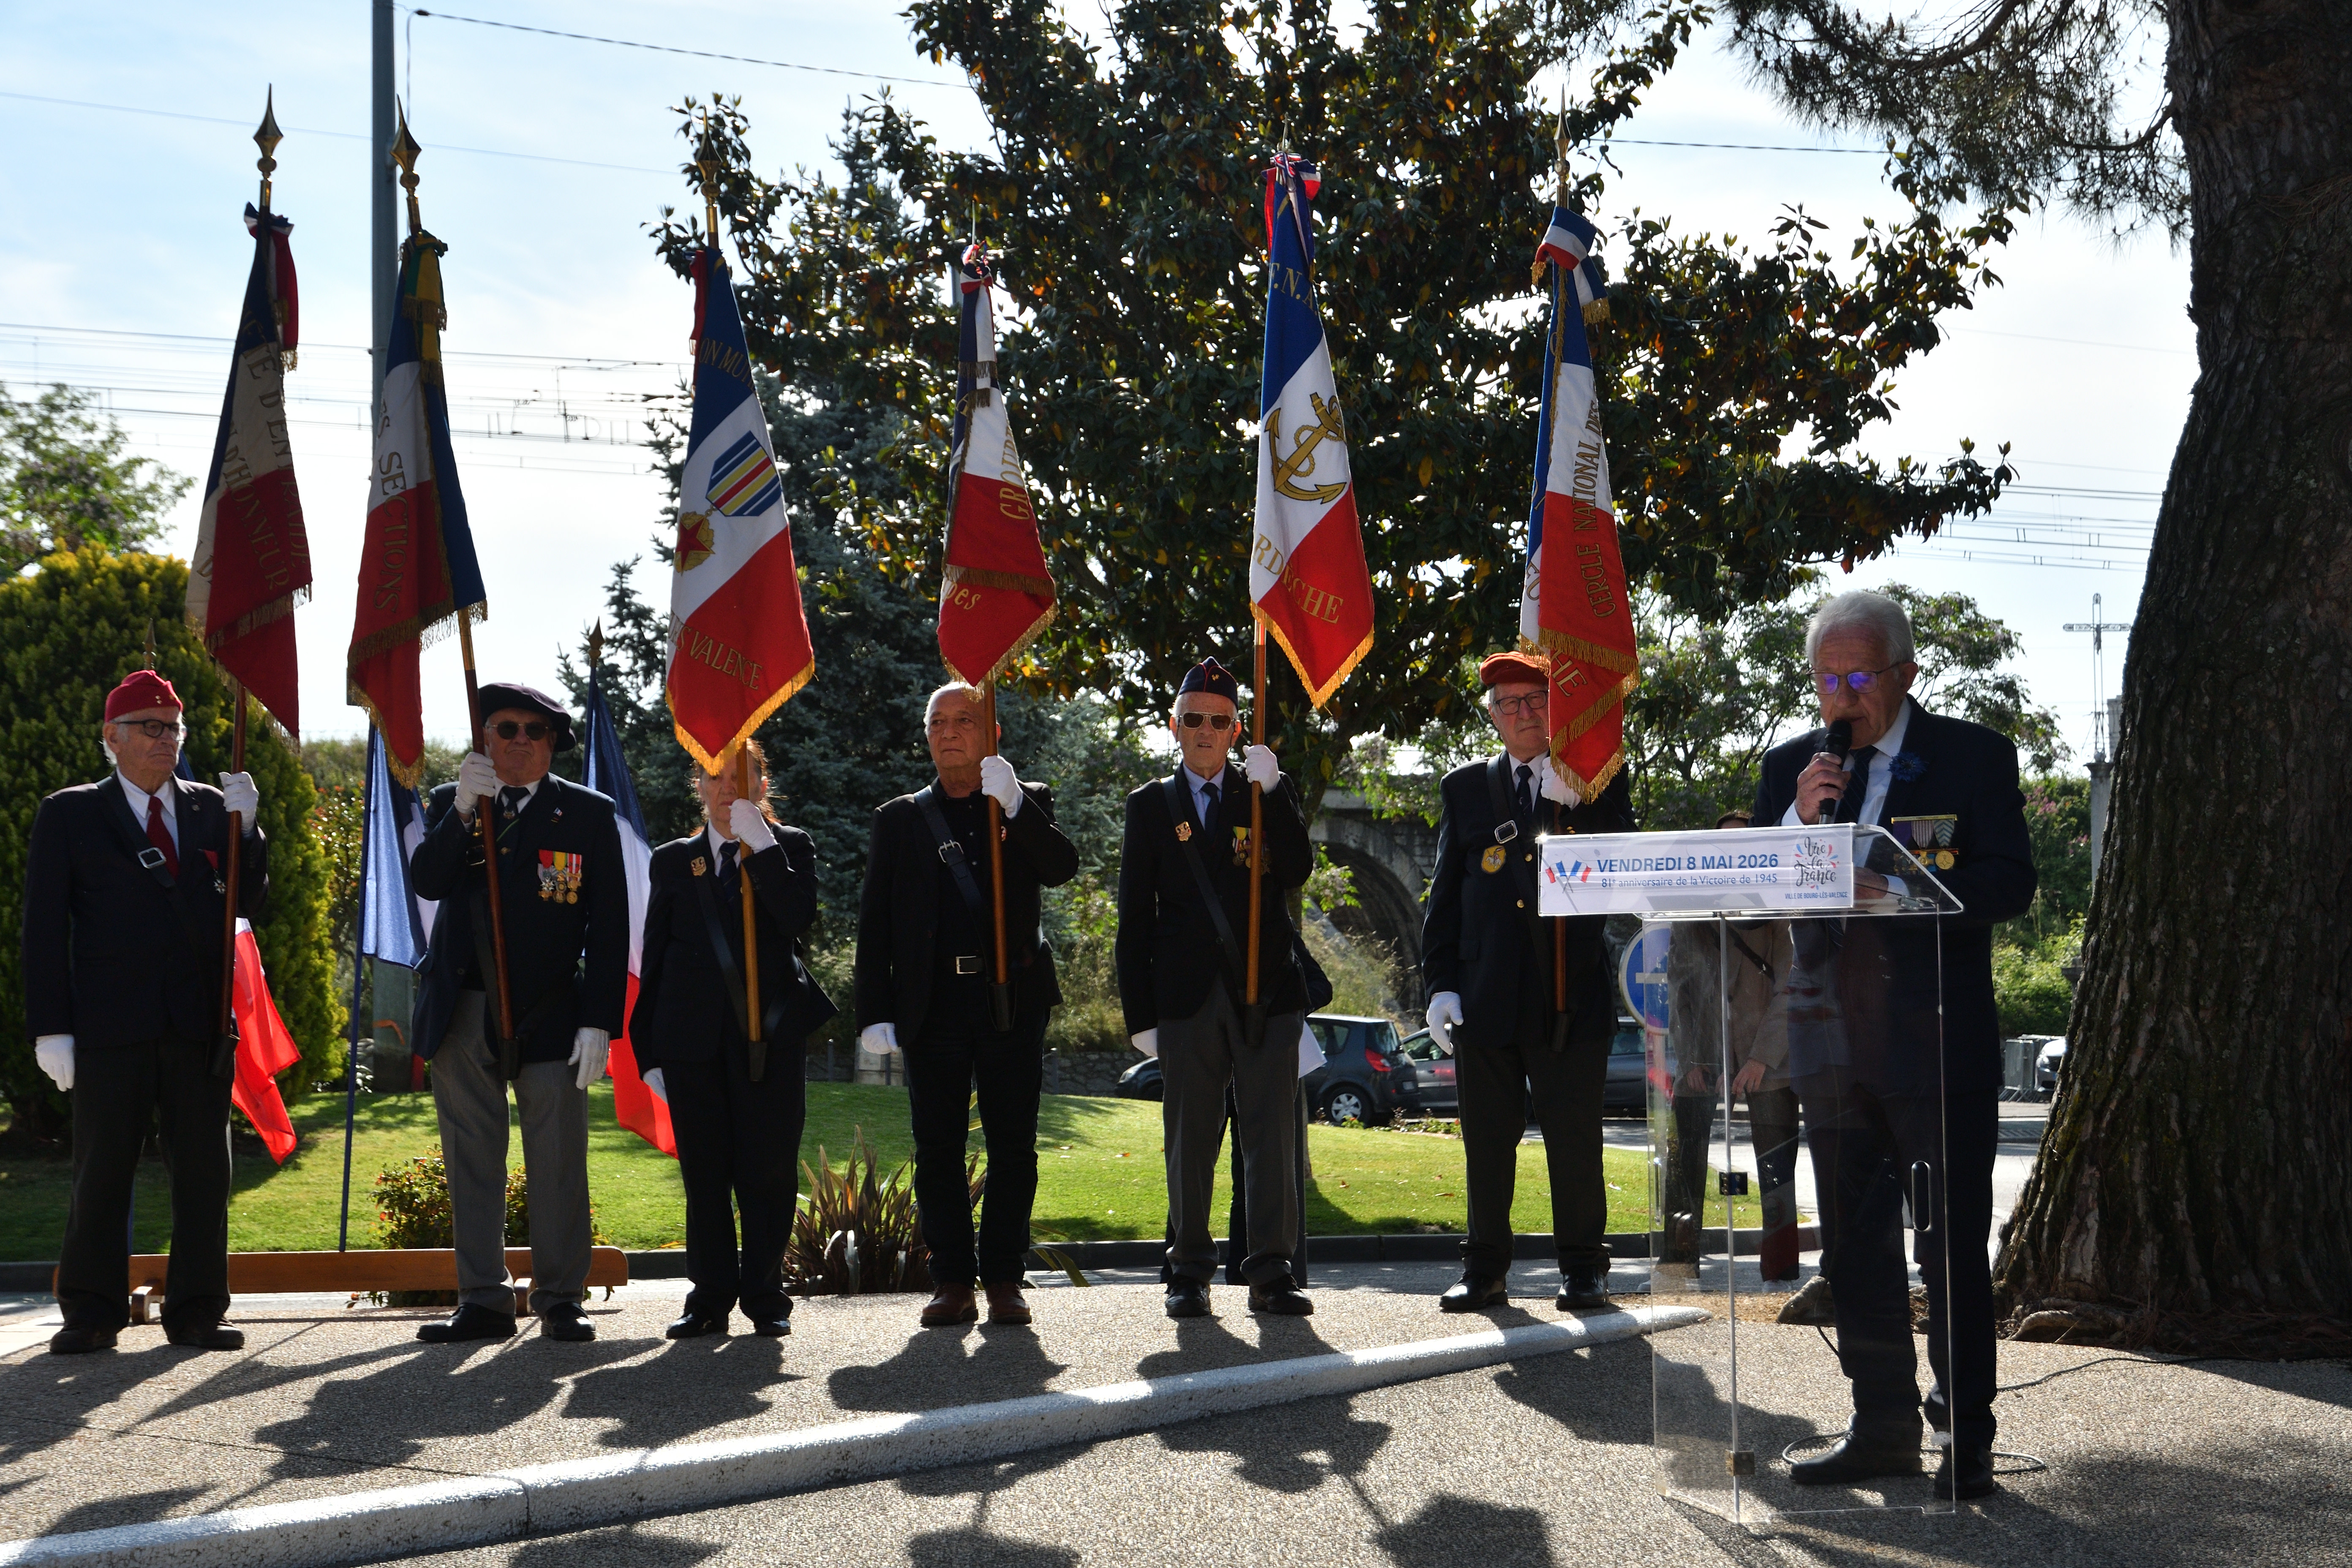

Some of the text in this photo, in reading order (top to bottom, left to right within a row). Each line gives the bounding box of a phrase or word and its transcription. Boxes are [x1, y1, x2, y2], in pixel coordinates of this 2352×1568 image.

[1572, 440, 1601, 531] NATIONAL
[373, 451, 409, 614] SECTIONS
[1577, 543, 1617, 618] CERCLE
[689, 631, 762, 690] VALENCE
[1804, 836, 1826, 857] Vive
[1597, 853, 1778, 873] VENDREDI 8 MAI 2026
[1794, 860, 1836, 887] France
[1807, 855, 1824, 870] la
[1618, 877, 1673, 887] anniversaire
[1676, 876, 1687, 885] de
[1690, 876, 1698, 885] la
[1699, 875, 1736, 885] Victoire
[1740, 874, 1750, 884] de
[1756, 873, 1778, 883] 1945
